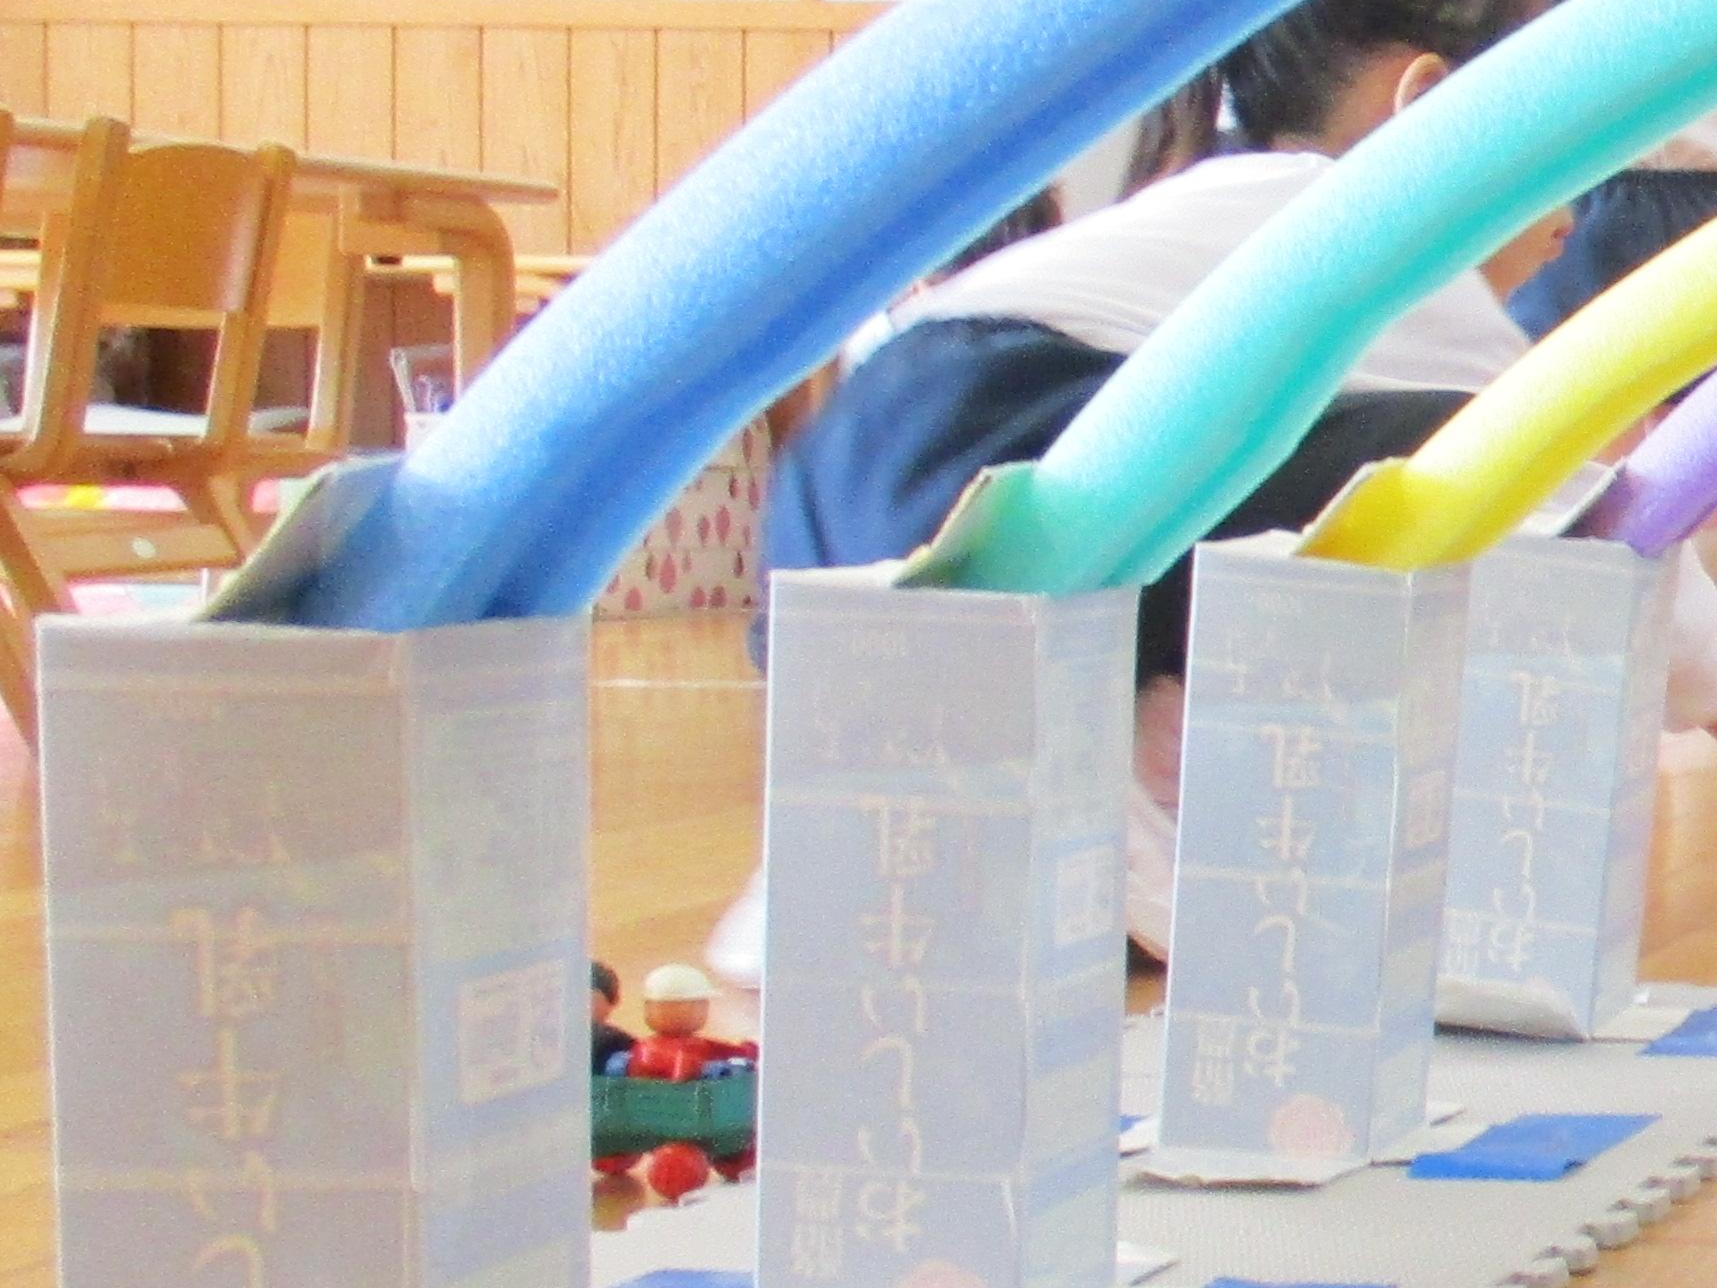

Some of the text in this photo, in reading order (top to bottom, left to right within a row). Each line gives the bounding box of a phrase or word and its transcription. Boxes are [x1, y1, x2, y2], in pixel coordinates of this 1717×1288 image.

[1245, 723, 1323, 1088] おいしい牛乳
[1489, 670, 1563, 971] おいしい牛乳
[855, 794, 938, 1253] おいしい牛乳
